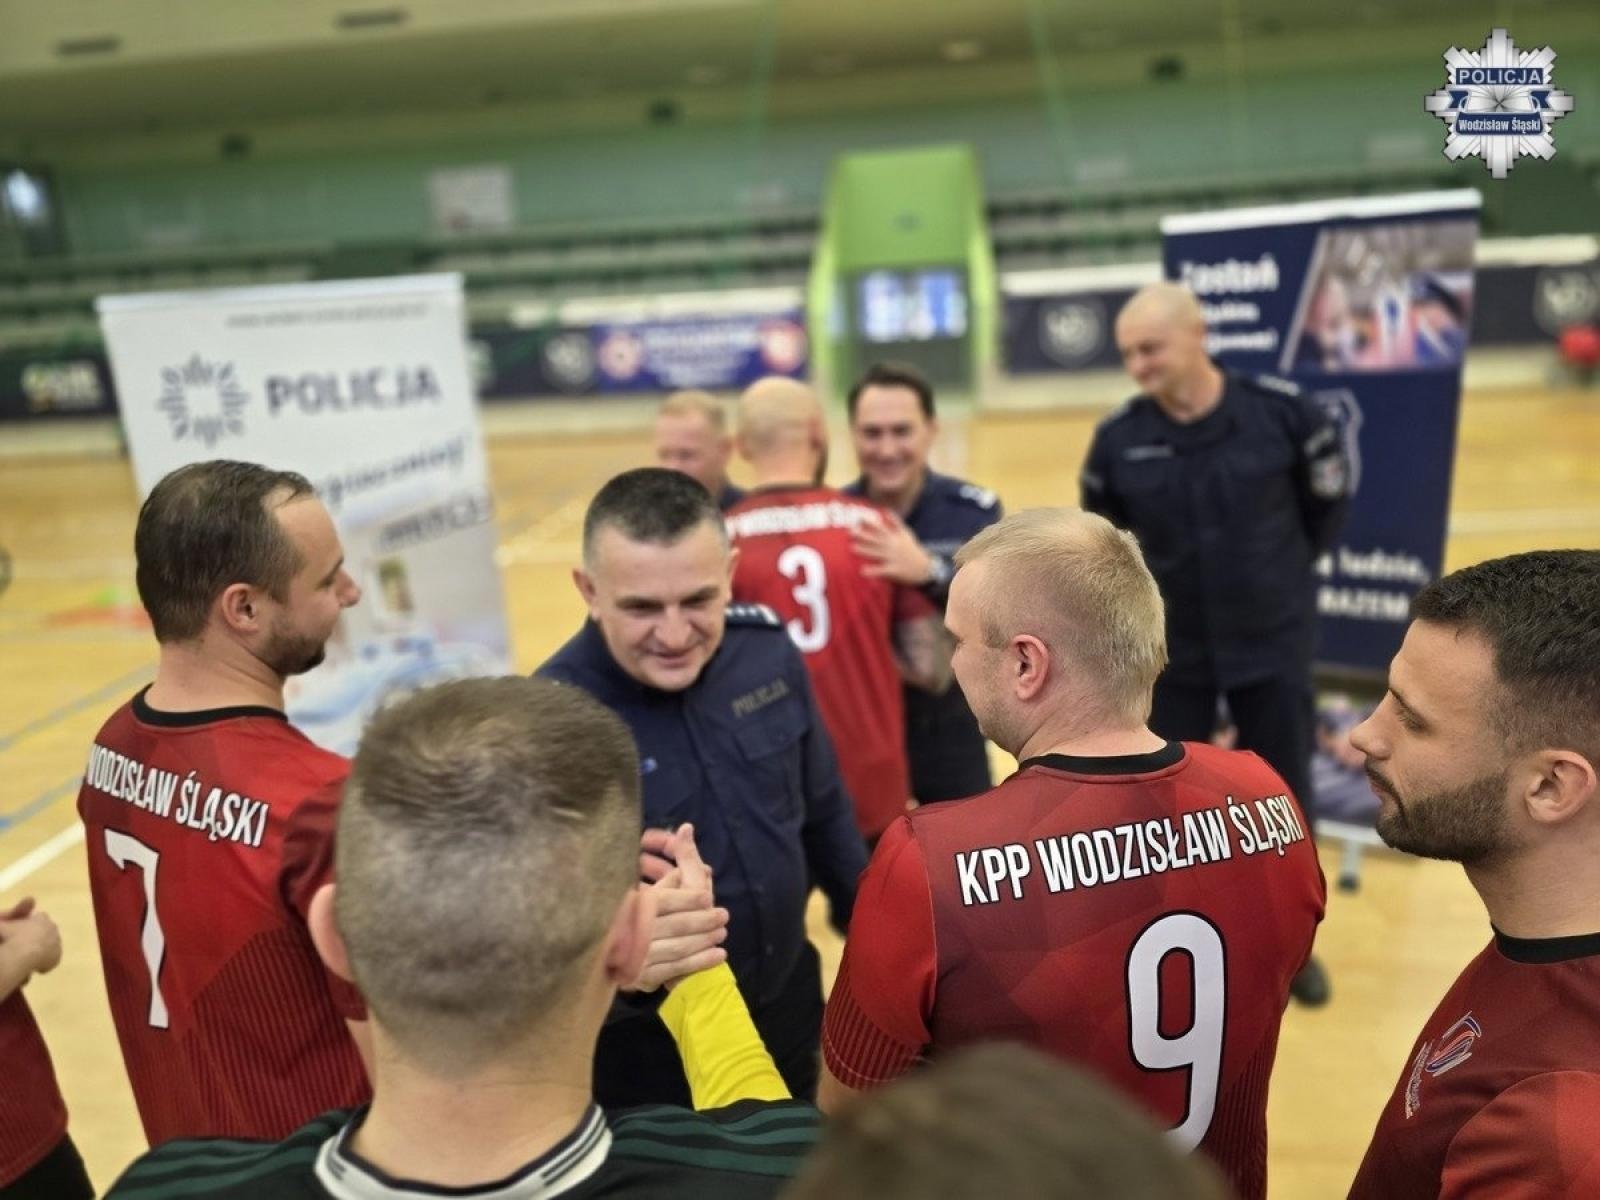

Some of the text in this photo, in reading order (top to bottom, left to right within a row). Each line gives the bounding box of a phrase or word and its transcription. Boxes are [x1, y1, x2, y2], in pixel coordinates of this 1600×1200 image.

[265, 366, 441, 417] POLICJA
[778, 544, 830, 652] 3
[176, 771, 269, 848] ŚLĄSKI
[955, 794, 1306, 906] KPP WODZISŁAW ŚLĄSKI
[103, 828, 168, 1029] 7
[1126, 912, 1226, 1158] 9
